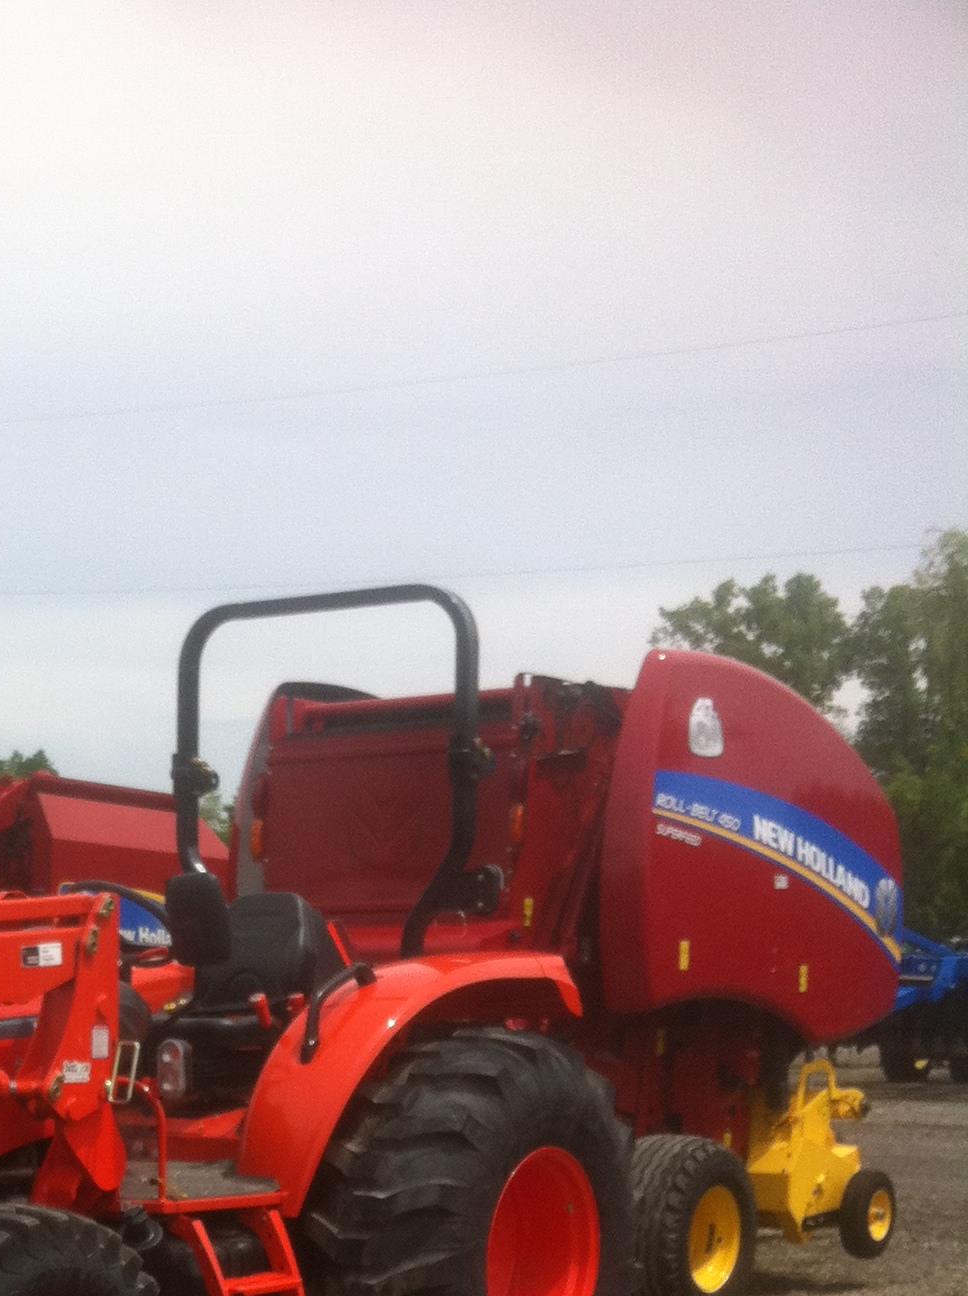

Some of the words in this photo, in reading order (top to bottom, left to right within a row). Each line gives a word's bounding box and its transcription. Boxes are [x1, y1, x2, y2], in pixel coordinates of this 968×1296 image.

[752, 814, 795, 856] NEW
[795, 835, 870, 909] HOLLAND
[139, 927, 172, 946] Holla
